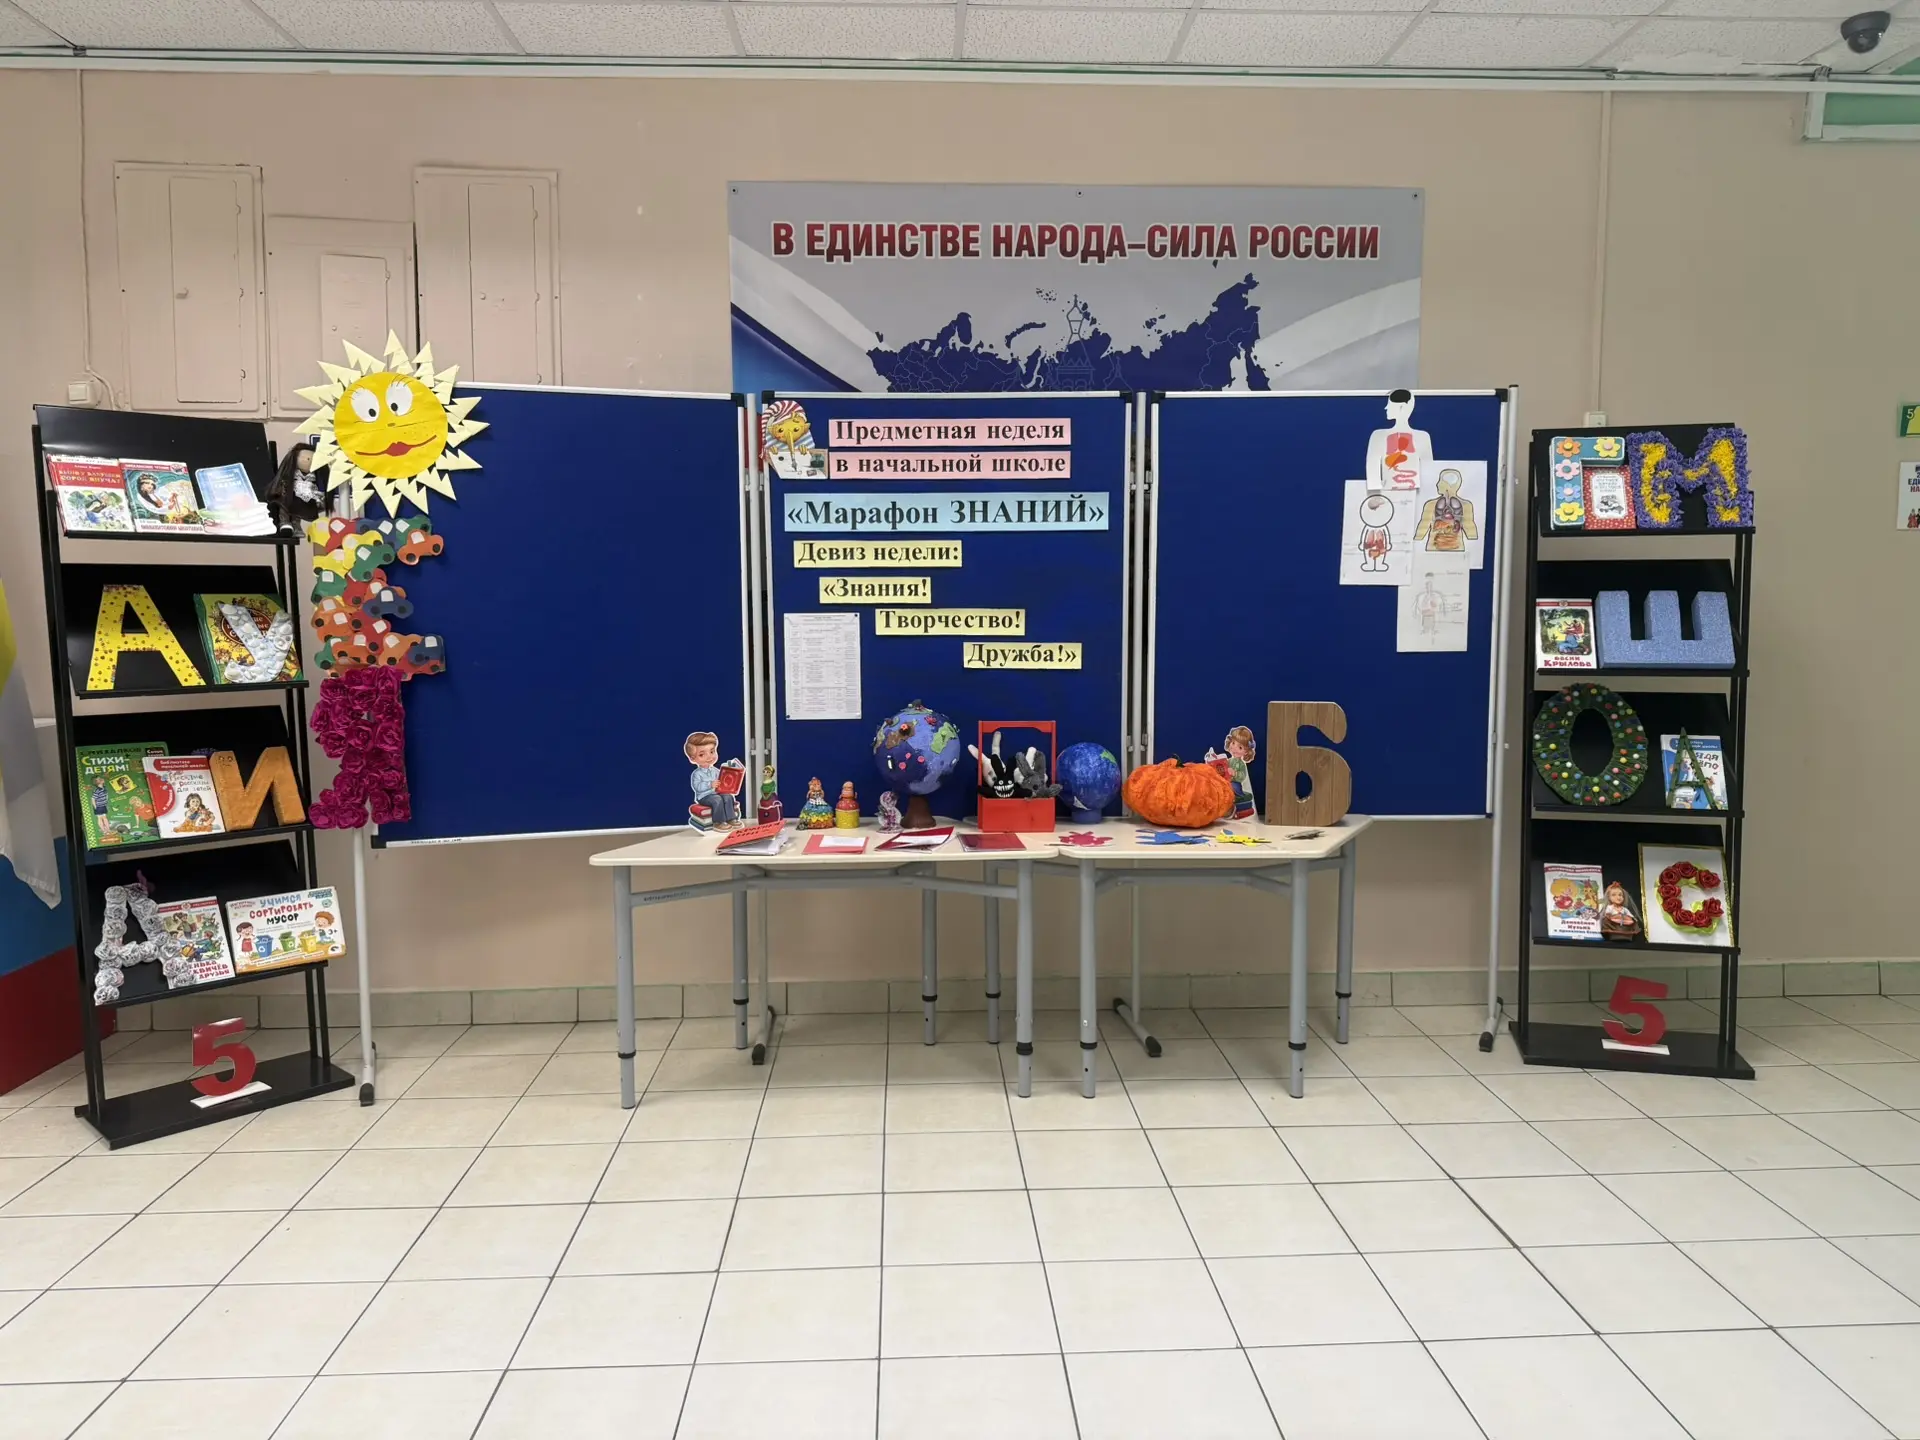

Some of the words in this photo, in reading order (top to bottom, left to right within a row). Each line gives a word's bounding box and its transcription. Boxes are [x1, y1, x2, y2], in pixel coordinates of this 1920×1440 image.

[772, 222, 796, 256] В
[805, 222, 981, 264] ЕДИНСТВЕ
[1248, 225, 1381, 260] РОССИИ
[835, 420, 977, 443] Предметная
[986, 423, 1065, 441] неделя
[836, 457, 849, 473] в
[858, 454, 983, 474] начальной
[991, 457, 1066, 473] школе
[1627, 428, 1754, 529] М
[787, 500, 938, 531] «Марафон
[949, 494, 1105, 524] ЗНАНИЙ»
[798, 541, 866, 564] Девиз
[873, 544, 960, 563] недели:
[823, 577, 928, 598] «Знания!
[880, 609, 1021, 632] Творчество!
[86, 584, 206, 691] А
[967, 643, 1077, 668] Дружба!»
[1264, 700, 1353, 827] Б
[209, 745, 306, 832] И
[249, 902, 314, 920] СОРТИРОВАТЬ
[260, 893, 302, 907] УЧИМСЯ
[266, 913, 300, 926] МУСОР
[1602, 975, 1669, 1047] 5
[191, 1017, 257, 1097] 5
